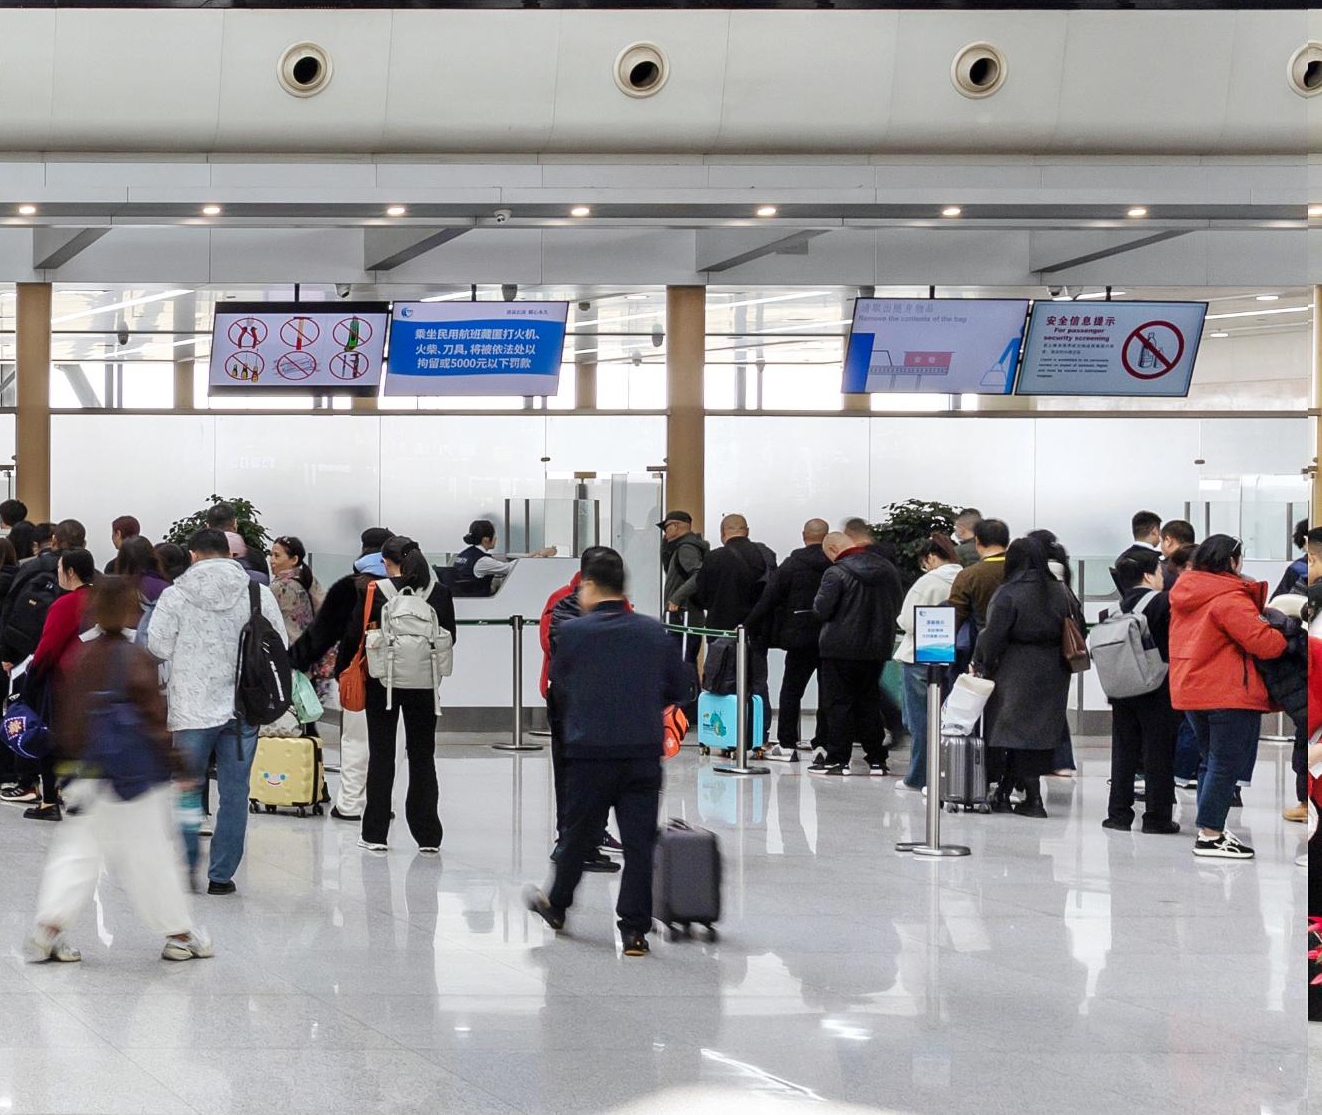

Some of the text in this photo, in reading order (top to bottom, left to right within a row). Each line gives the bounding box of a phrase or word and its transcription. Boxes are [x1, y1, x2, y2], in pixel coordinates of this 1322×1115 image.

[1046, 315, 1116, 326] 安全信息提示
[417, 357, 532, 369] 拘留或5000元以下罚款
